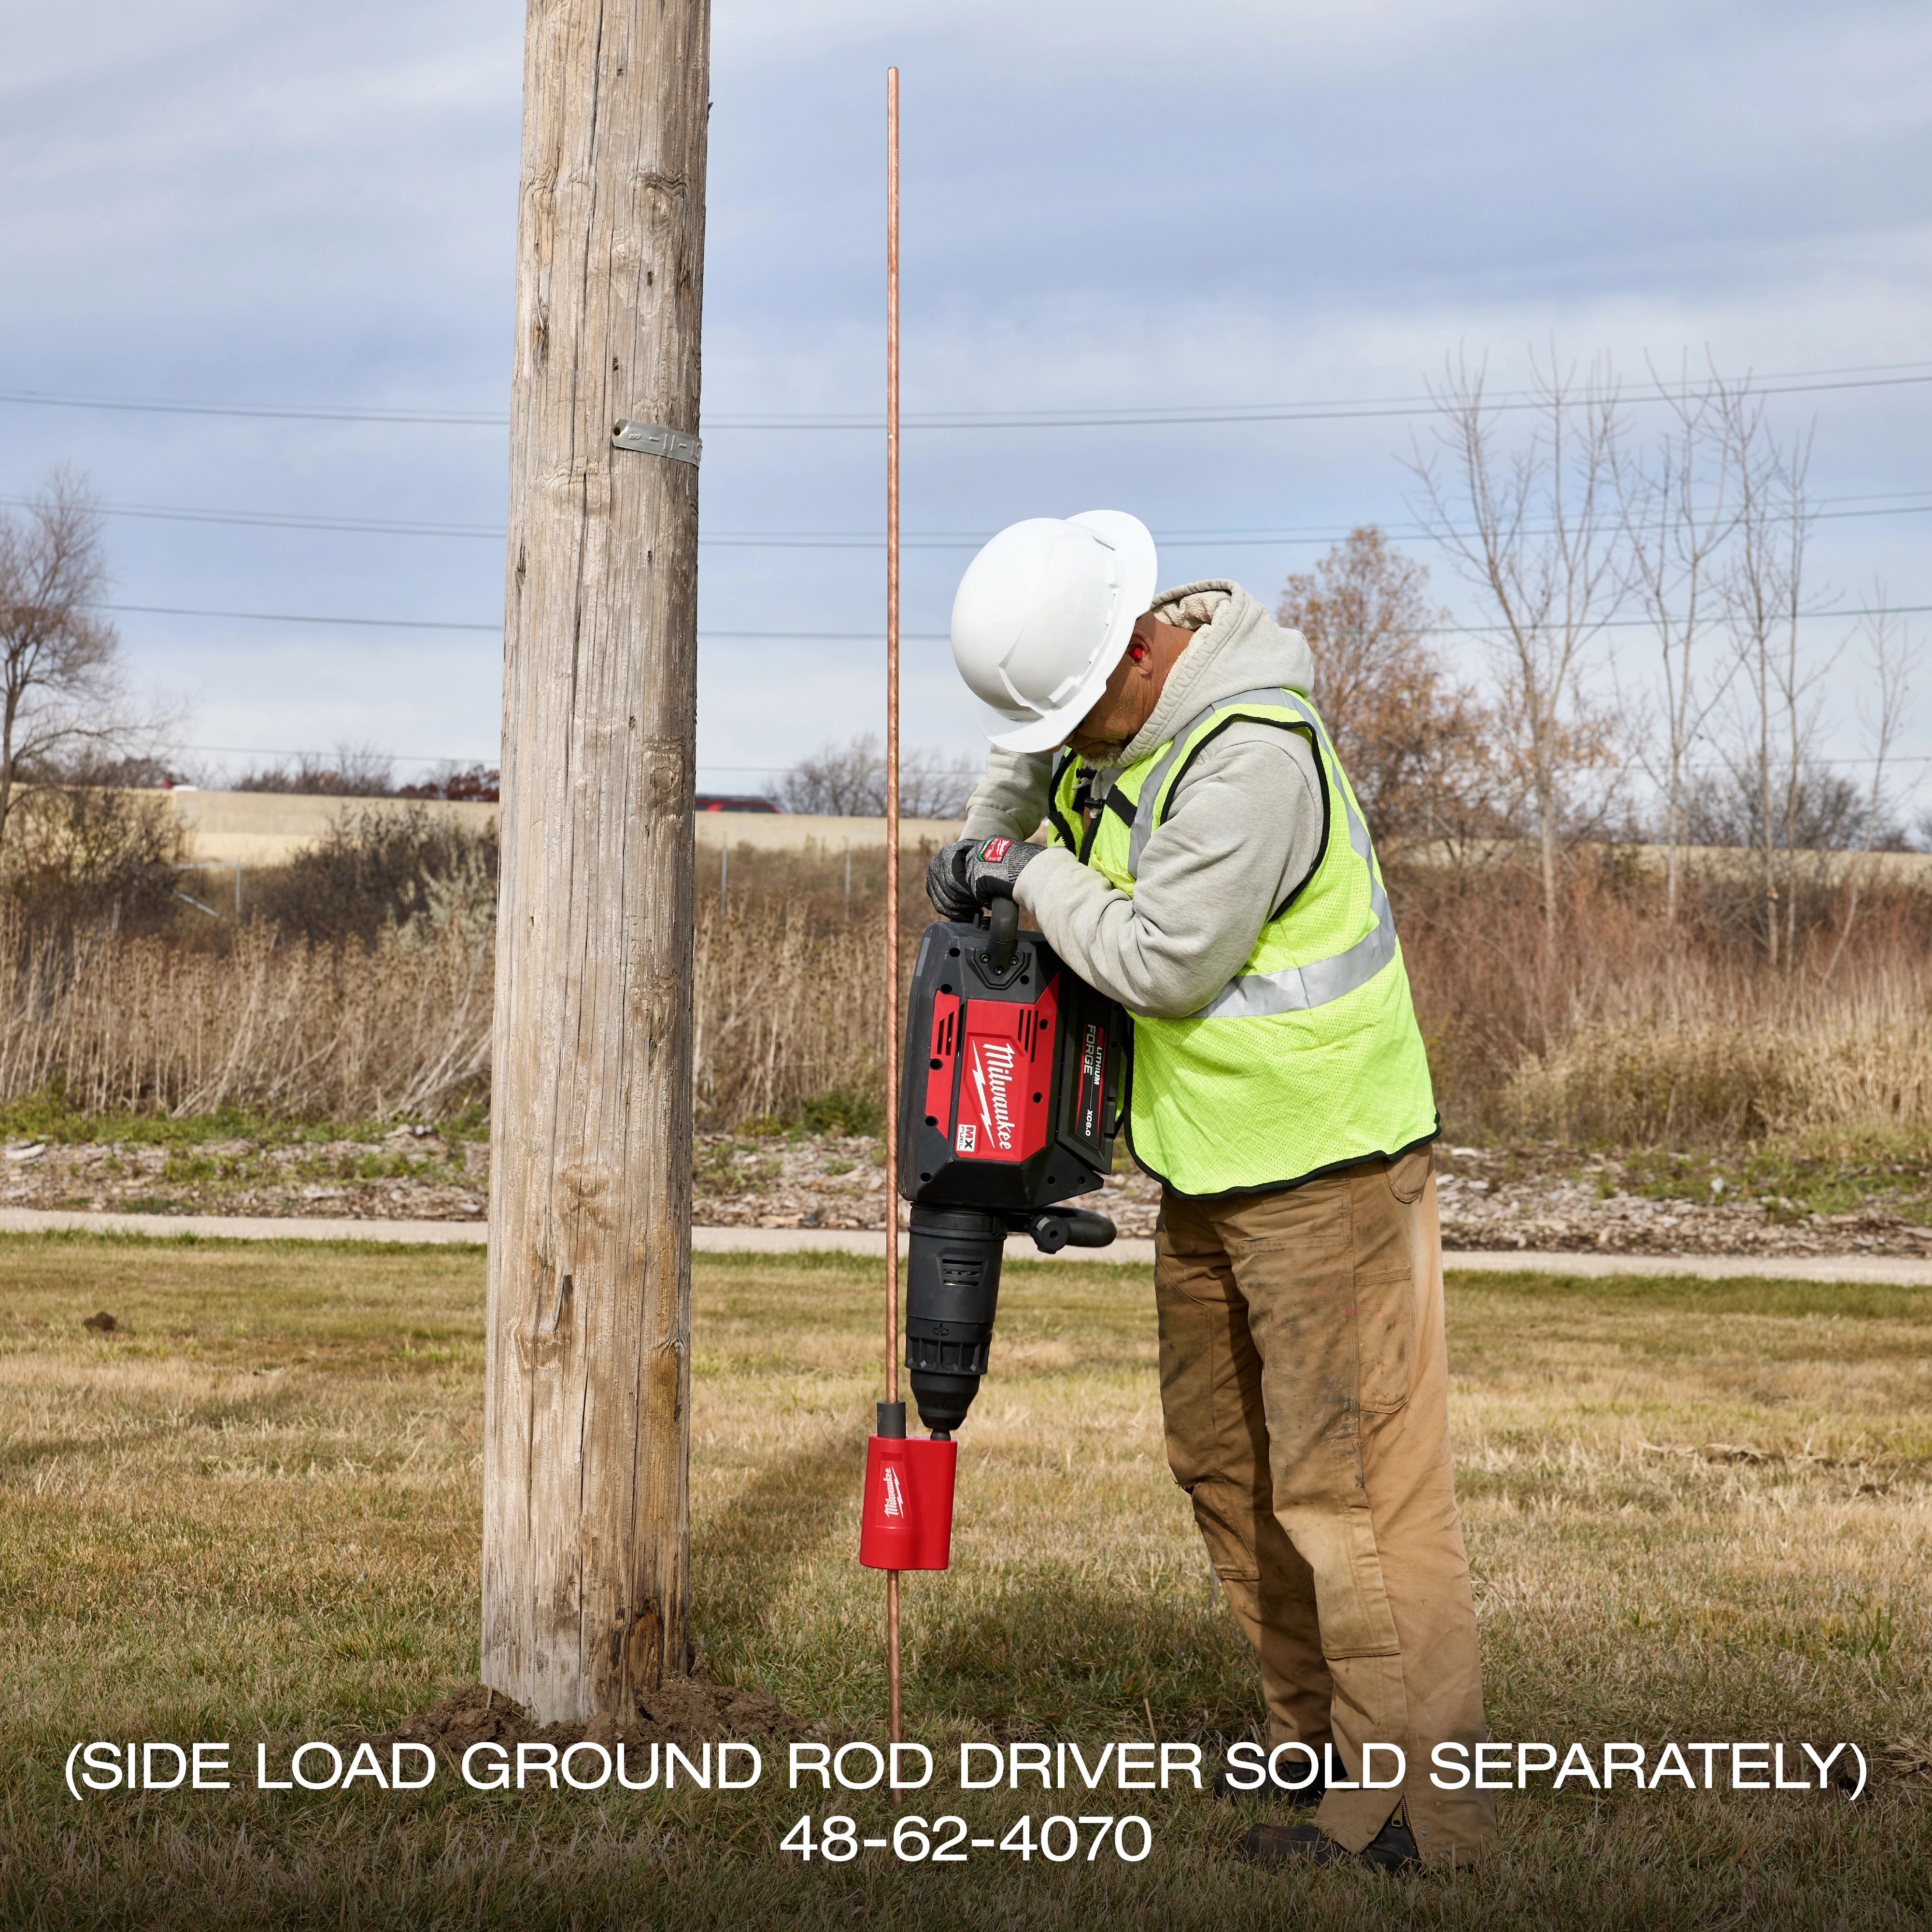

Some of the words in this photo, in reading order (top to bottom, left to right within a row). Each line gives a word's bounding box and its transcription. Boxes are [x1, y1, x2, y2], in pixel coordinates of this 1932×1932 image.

[1084, 1024, 1096, 1076] FORGE
[1094, 1026, 1104, 1085] REDLITHIUM
[982, 1043, 1016, 1150] Milwaukee
[965, 1126, 974, 1150] MX
[883, 1467, 899, 1518] Milwaukee
